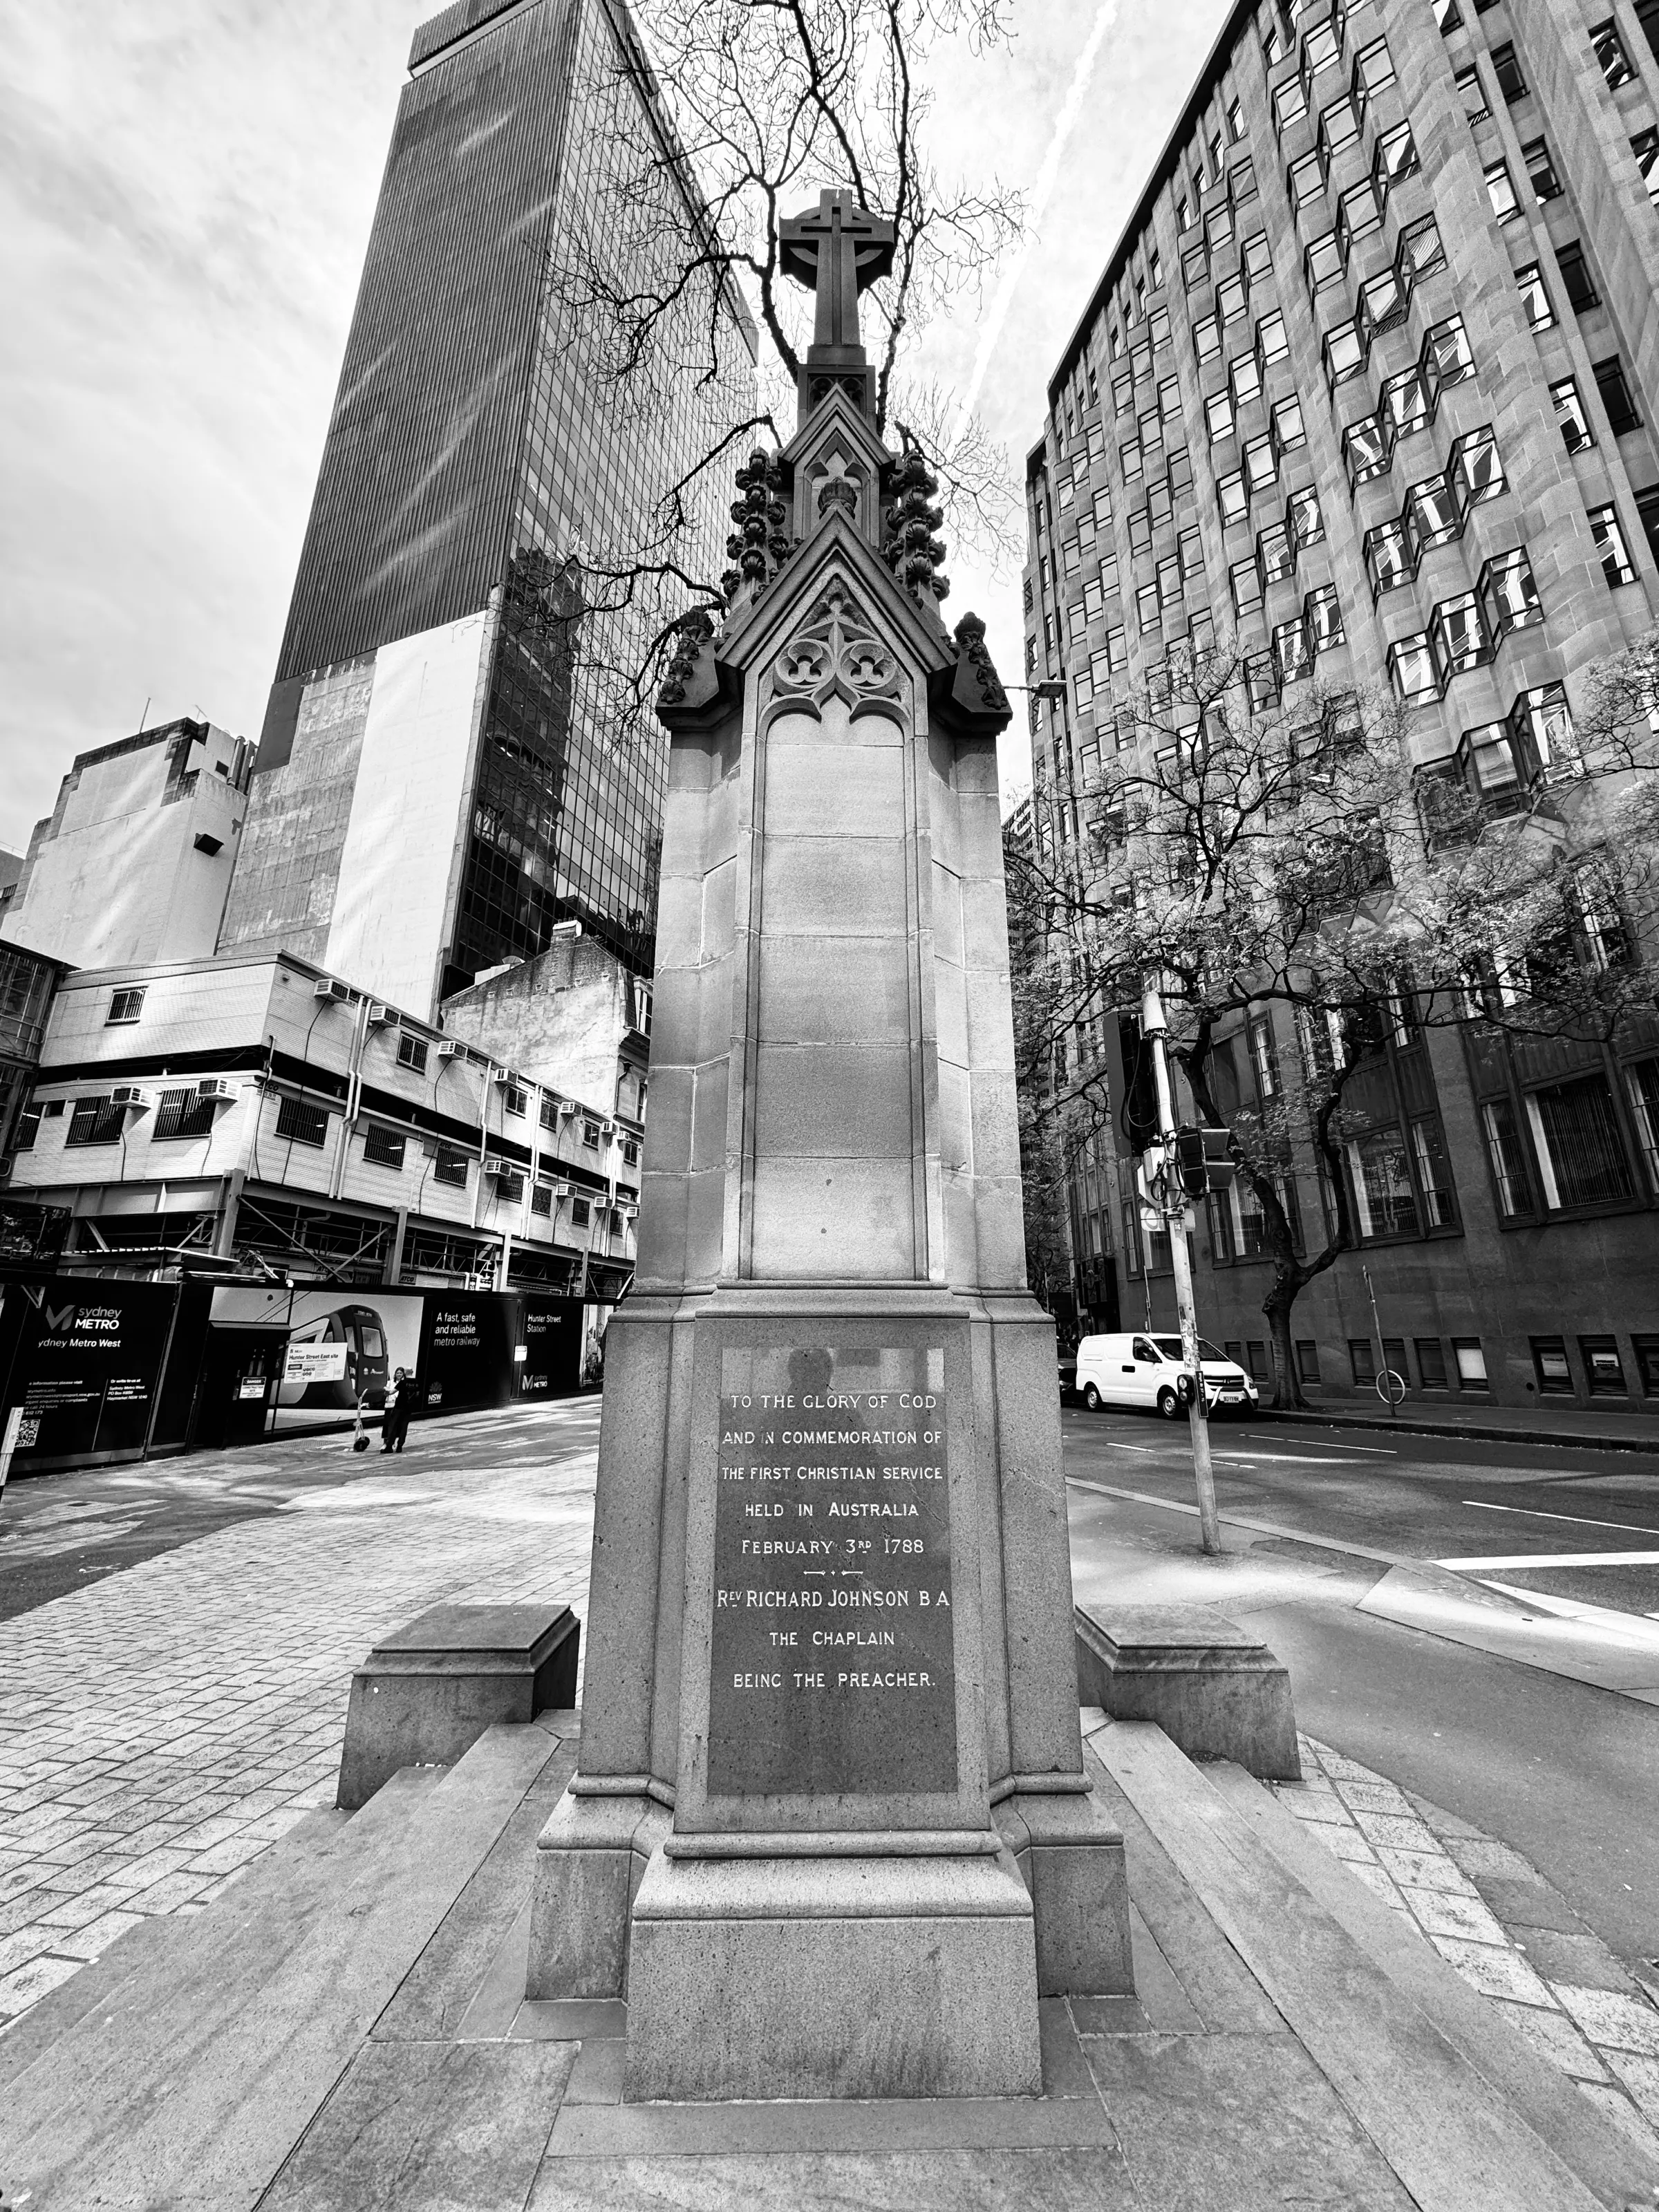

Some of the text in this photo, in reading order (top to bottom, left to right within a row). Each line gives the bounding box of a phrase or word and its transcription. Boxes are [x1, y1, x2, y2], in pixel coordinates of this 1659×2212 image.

[259, 1080, 279, 1091] ACO
[78, 1306, 122, 1319] sydney
[436, 1312, 476, 1323] A fast, safe
[527, 1314, 561, 1323] Hunter Street
[75, 1319, 120, 1330] METRO
[435, 1324, 476, 1334] and reliable
[527, 1324, 547, 1333] Station
[69, 1338, 97, 1347] Metro
[99, 1339, 122, 1347] West
[433, 1336, 480, 1347] metro railway
[428, 1393, 442, 1401] NSW
[731, 1395, 751, 1408] TO
[760, 1395, 796, 1408] THE
[803, 1395, 861, 1408] GLORY
[868, 1395, 889, 1408] OF
[722, 1431, 942, 1444] AND IN COMMEMORATION OF
[722, 1466, 943, 1479] THE FIRST CHRISTIAN SERVICE
[745, 1501, 919, 1517] HELD IN AUSTRALIA
[742, 1539, 834, 1554] FEBRUARY
[884, 1539, 924, 1554] 1788
[746, 1590, 823, 1607] RICHARD
[827, 1589, 909, 1607] JOHNSON
[919, 1590, 930, 1606] B
[935, 1590, 950, 1606] A
[769, 1631, 894, 1645] THE CHAPLAIN
[793, 1674, 825, 1687] THE
[838, 1673, 936, 1687] PREACHER.
